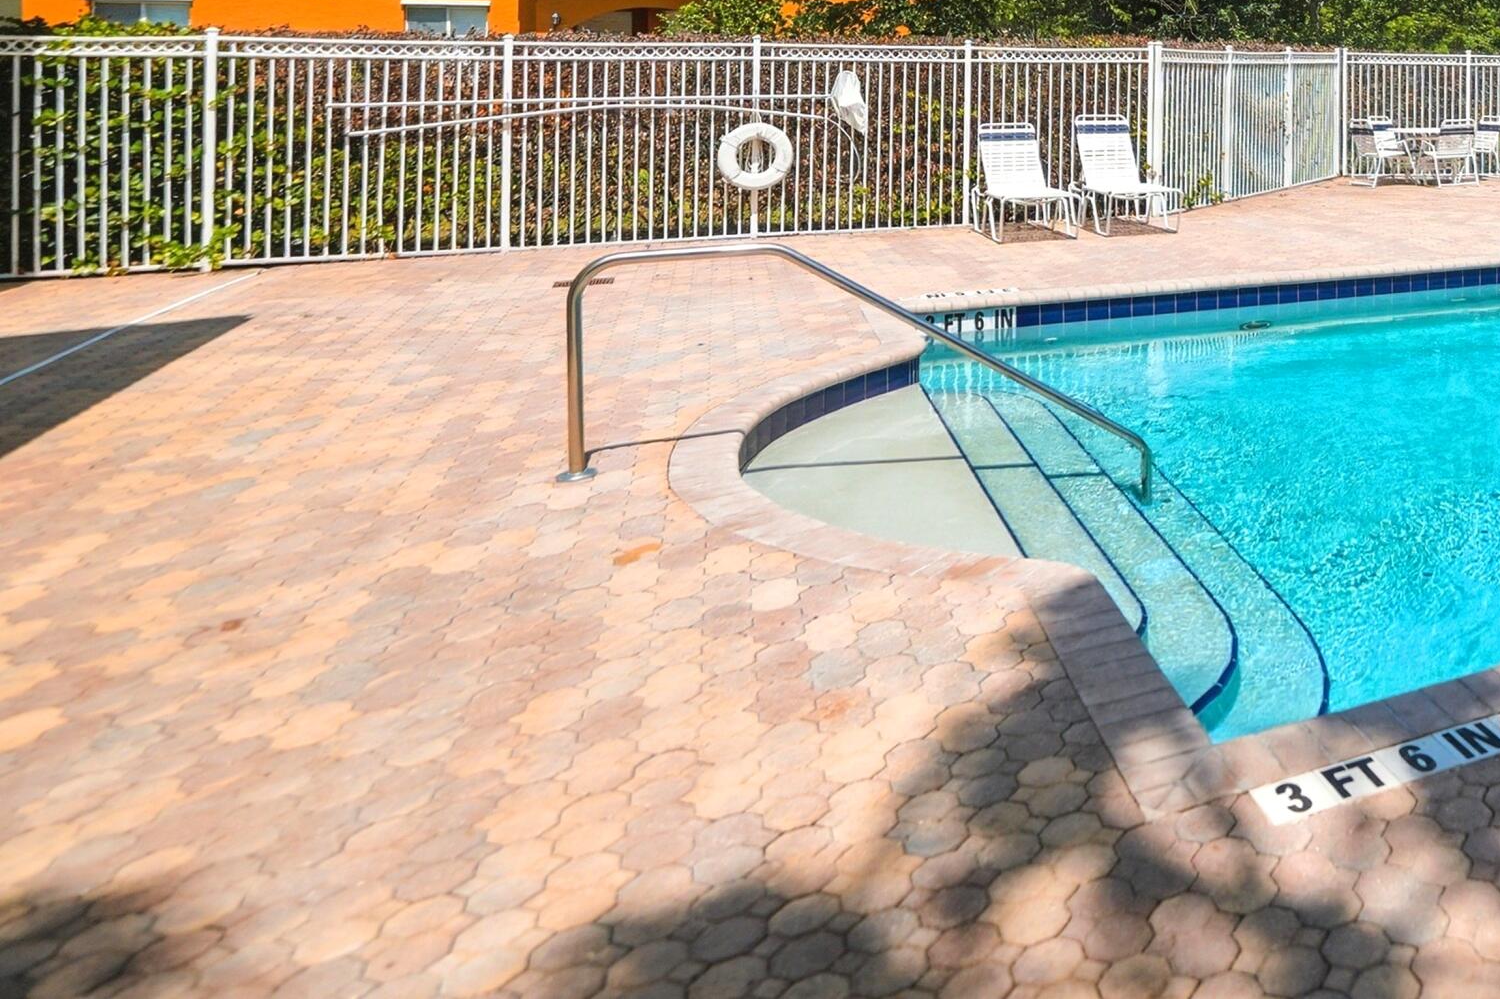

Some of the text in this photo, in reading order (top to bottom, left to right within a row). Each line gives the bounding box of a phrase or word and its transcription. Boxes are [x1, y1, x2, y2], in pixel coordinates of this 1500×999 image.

[944, 312, 966, 333] FT
[974, 311, 984, 331] 6
[994, 307, 1015, 330] IN
[1275, 782, 1313, 813] 3
[1321, 757, 1385, 799] FT
[1399, 745, 1437, 773] 6
